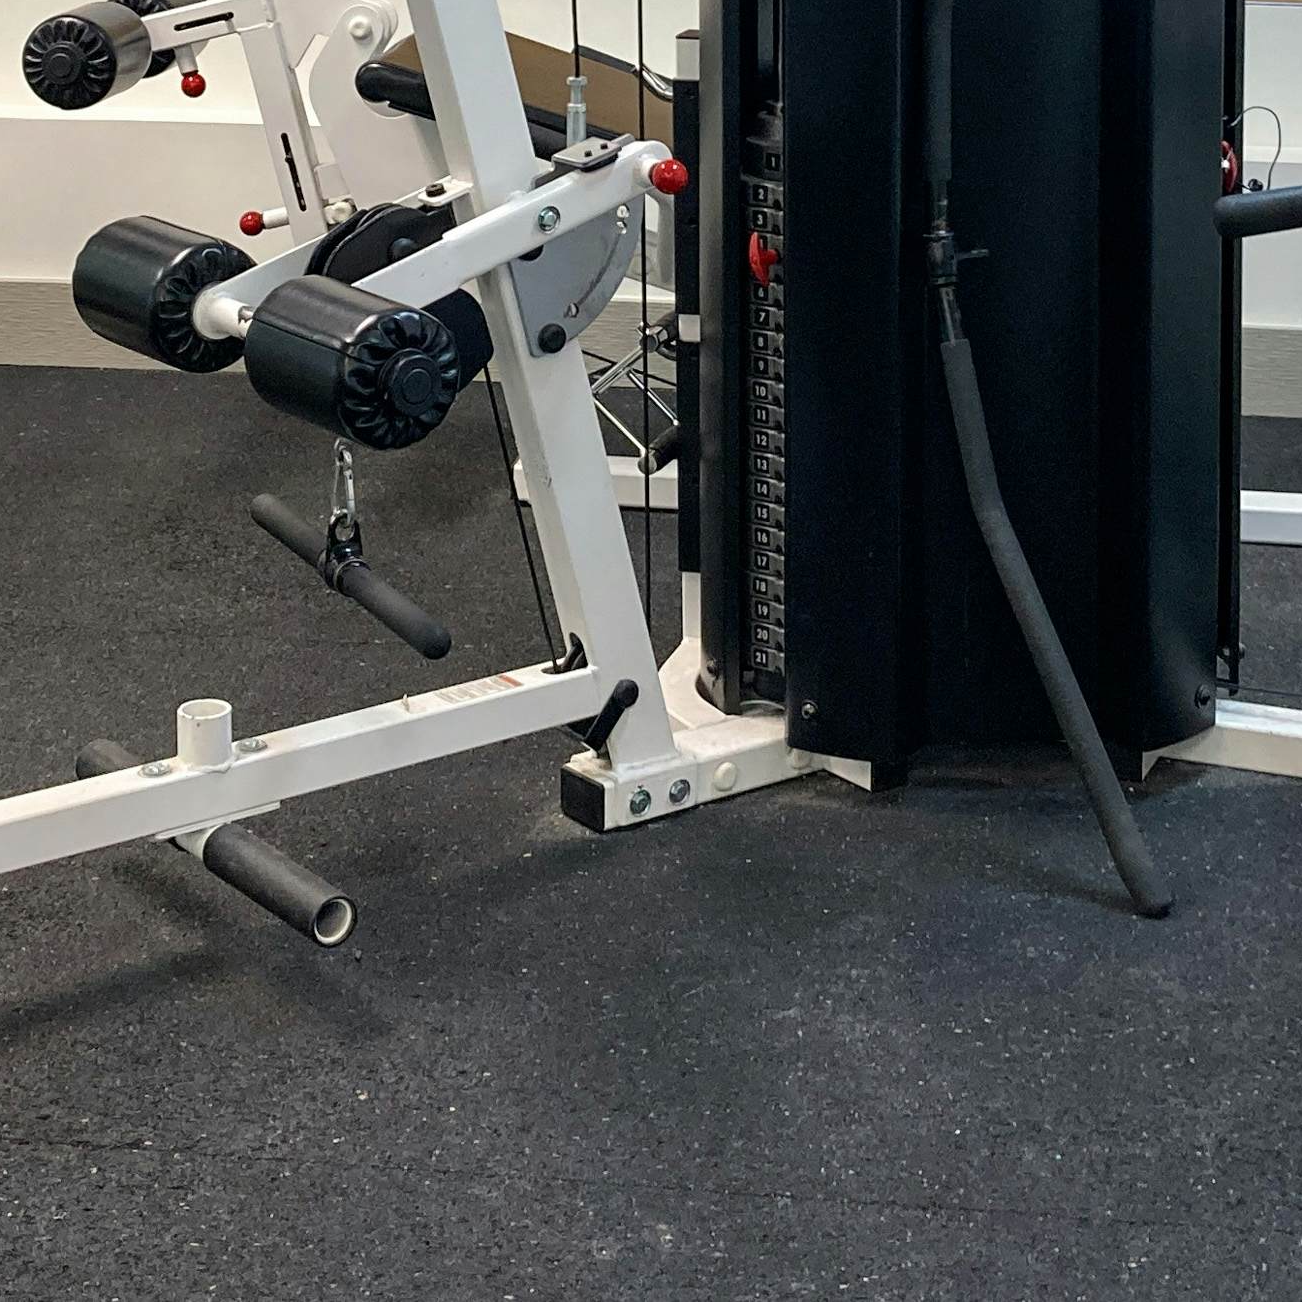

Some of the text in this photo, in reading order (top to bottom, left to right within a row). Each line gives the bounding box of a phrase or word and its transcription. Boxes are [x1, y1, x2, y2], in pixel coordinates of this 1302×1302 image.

[755, 385, 766, 397] 10
[757, 409, 766, 420] 11
[756, 434, 767, 445] 12
[757, 459, 767, 470] 13
[757, 483, 767, 494] 14
[757, 507, 767, 518] 15
[757, 532, 767, 543] 16
[757, 555, 766, 566] 17
[756, 580, 766, 591] 18
[757, 604, 767, 615] 19
[757, 628, 767, 640] 20
[756, 652, 766, 663] 21
